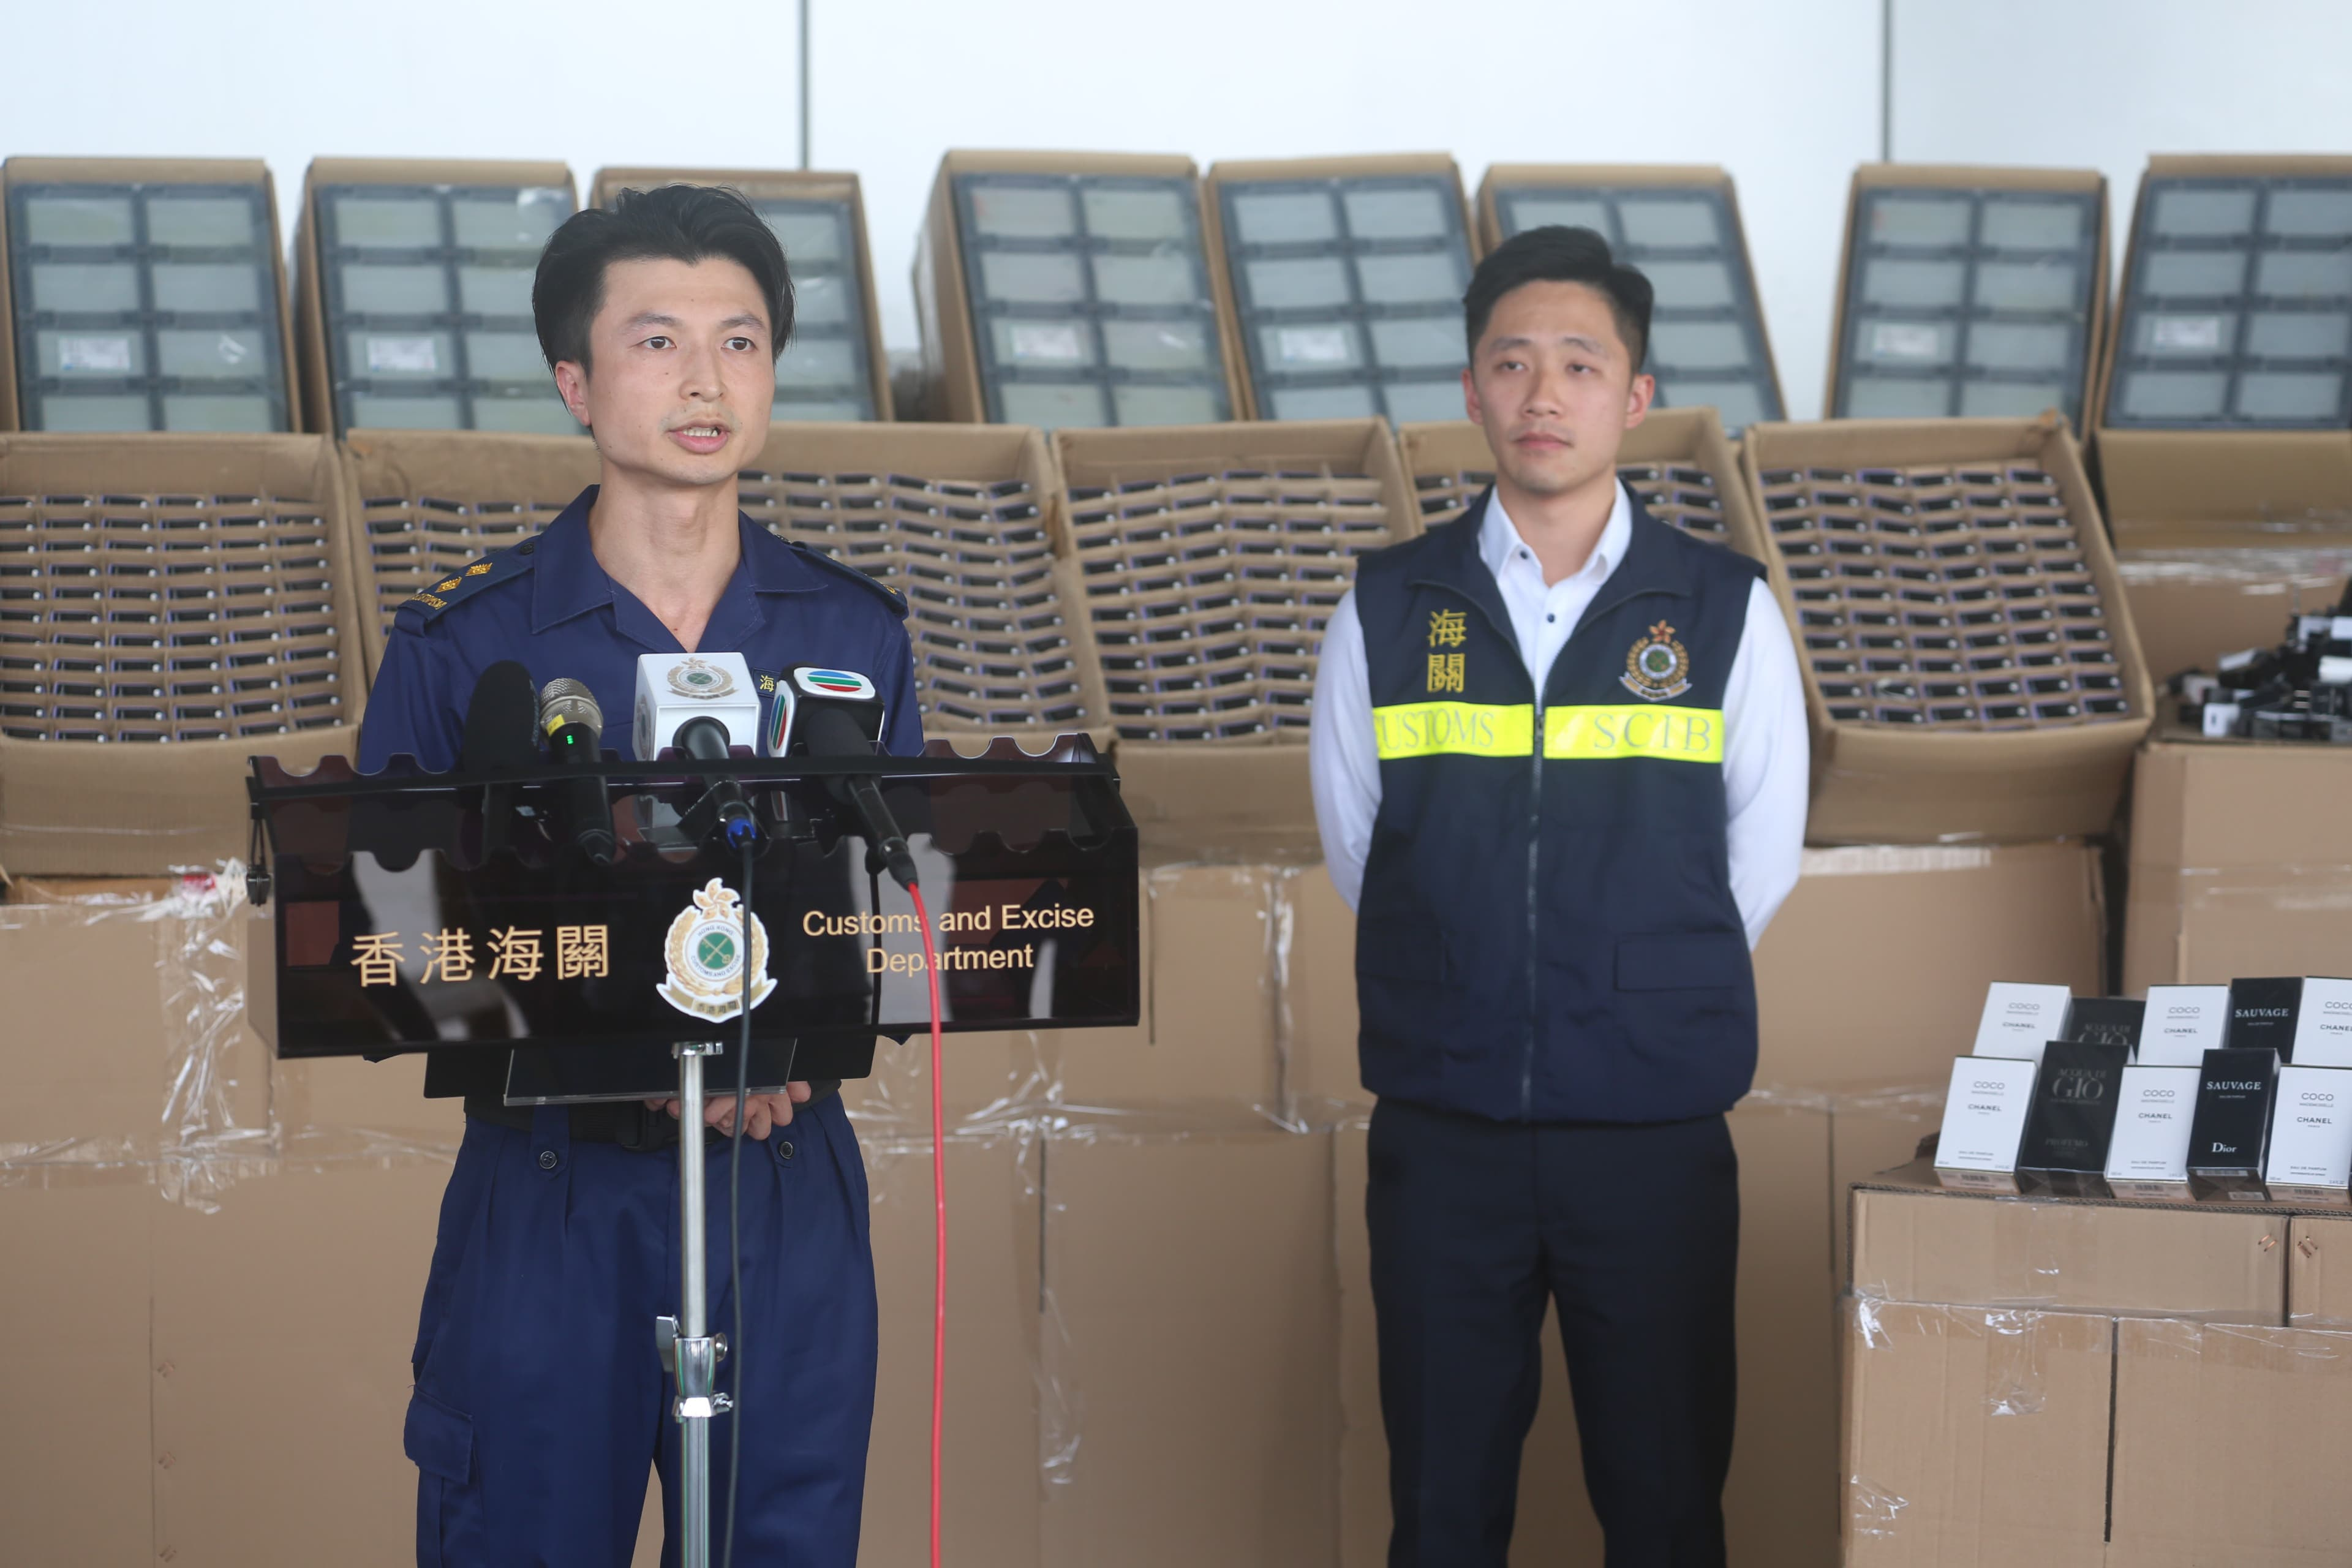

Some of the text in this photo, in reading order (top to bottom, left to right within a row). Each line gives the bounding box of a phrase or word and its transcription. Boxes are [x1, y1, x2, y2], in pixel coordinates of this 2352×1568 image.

[1427, 609, 1467, 693] 海關
[1374, 709, 1494, 750] USTOMS
[1594, 712, 1711, 752] SCIB
[939, 905, 990, 932] and
[1001, 903, 1094, 930] Excise
[350, 925, 609, 987] 香港海關
[2008, 1001, 2041, 1011] COCO
[2234, 1008, 2290, 1018] SAUVAGE
[1973, 1080, 2005, 1090] COCO
[2206, 1080, 2262, 1090] SAUVAGE
[2143, 1089, 2175, 1098] COCO
[2301, 1092, 2334, 1101] COCO
[1967, 1103, 2002, 1112] CHANEL
[2211, 1142, 2237, 1153] Dior
